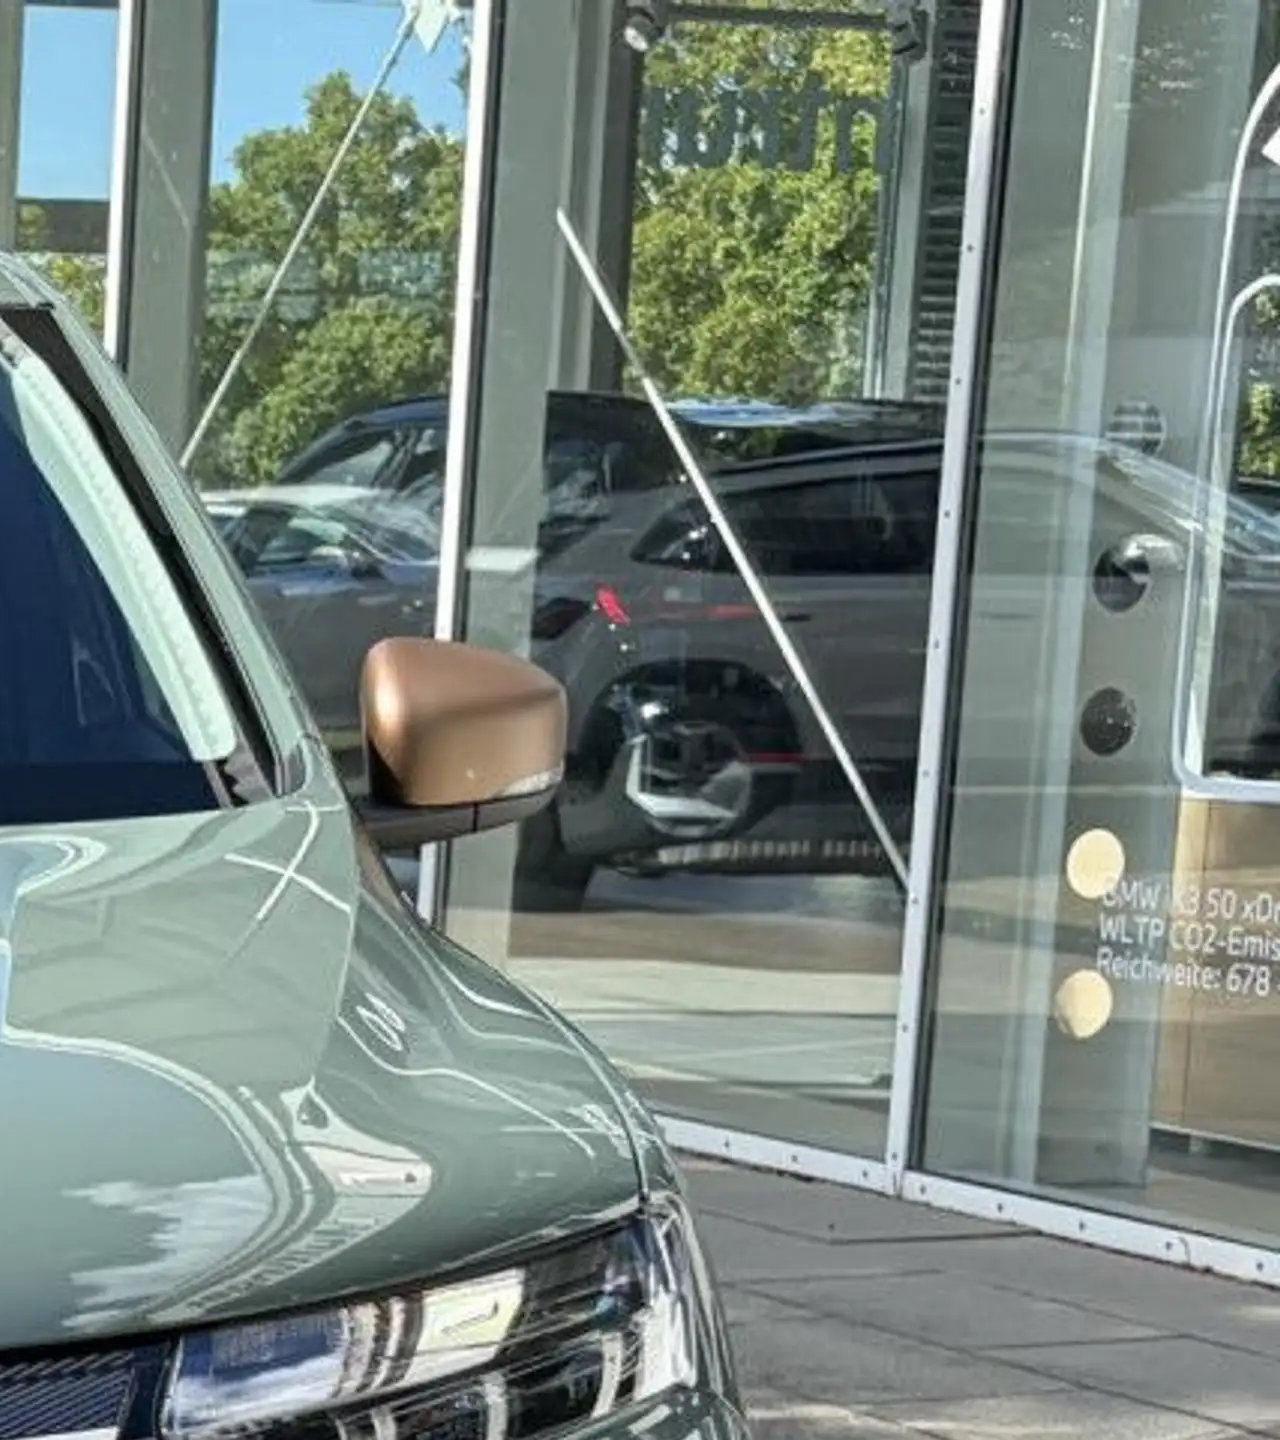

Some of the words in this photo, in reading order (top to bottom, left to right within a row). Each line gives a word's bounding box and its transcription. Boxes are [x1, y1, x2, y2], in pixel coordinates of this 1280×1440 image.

[1165, 882, 1201, 916] i3
[1206, 887, 1238, 919] 50
[1099, 912, 1165, 948] WLTP
[1226, 962, 1270, 997] 678
